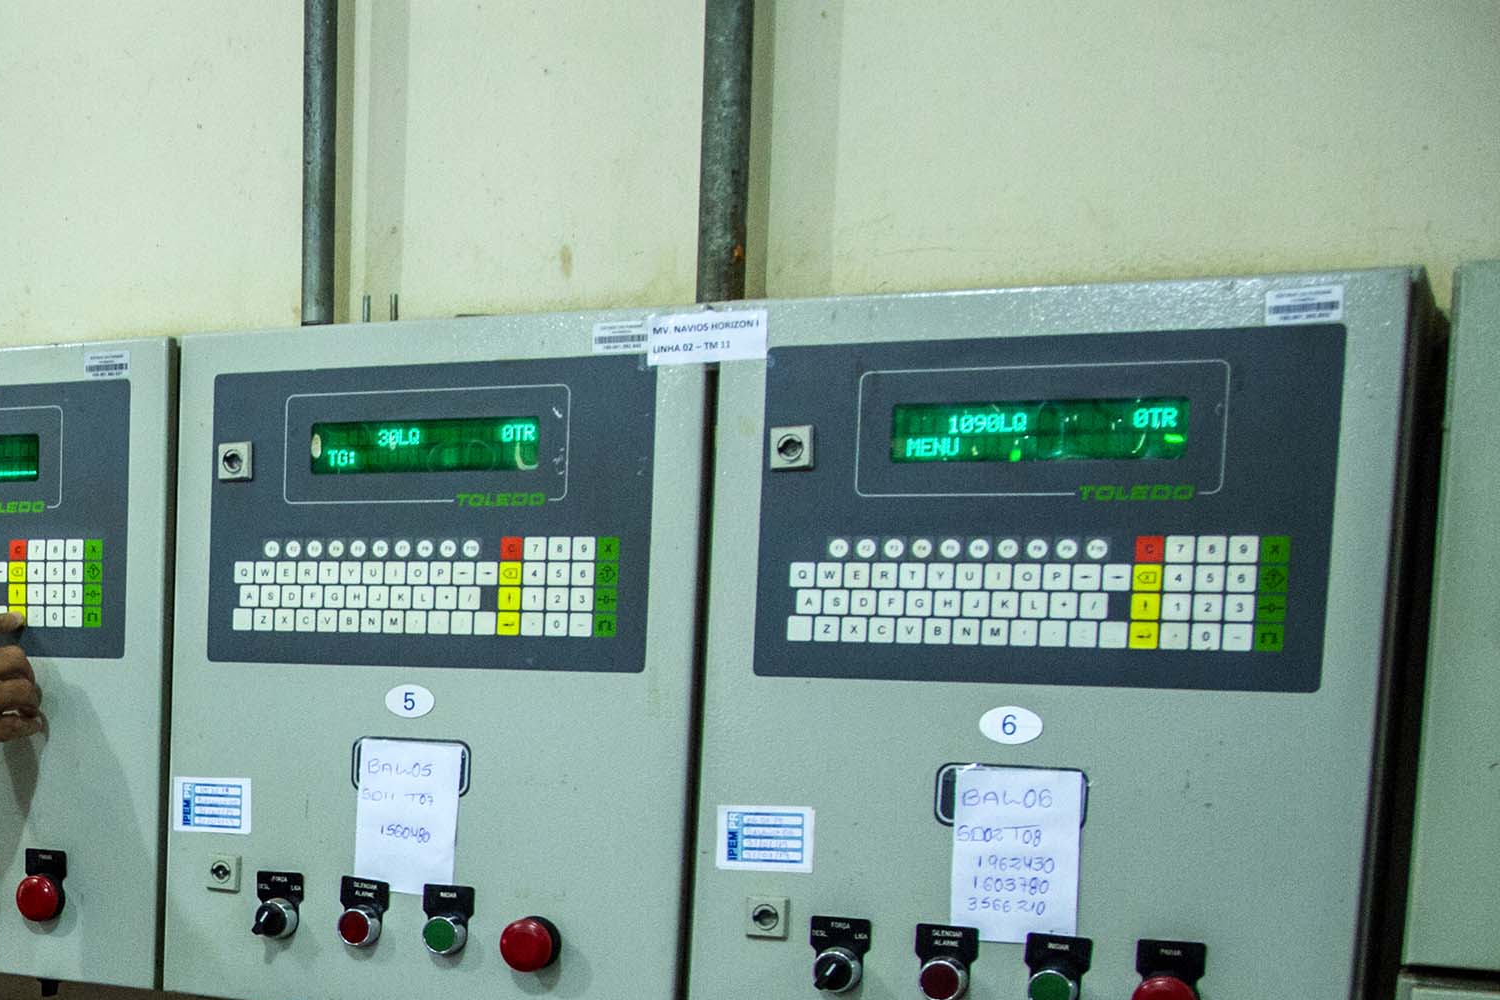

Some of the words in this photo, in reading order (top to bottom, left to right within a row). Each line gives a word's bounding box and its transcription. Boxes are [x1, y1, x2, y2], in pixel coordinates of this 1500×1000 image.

[653, 327, 672, 335] MV.
[674, 322, 709, 333] NAVIOS
[711, 320, 754, 331] HORIZON
[653, 344, 680, 354] LINHA
[682, 343, 694, 352] 02
[704, 341, 718, 350] TM
[948, 413, 1027, 434] 1090LQ
[1132, 407, 1178, 429] 0TR
[378, 427, 421, 447] 30LQ
[501, 423, 536, 443] 0TR
[906, 437, 960, 458] MENU
[456, 492, 547, 507] TOLEDO
[1078, 485, 1196, 501] TOLEDO
[1178, 543, 1185, 553] 7
[1208, 544, 1216, 554] 8
[1239, 544, 1248, 554] 9
[798, 570, 807, 579] Q
[825, 570, 835, 580] W
[853, 570, 860, 580] E
[880, 570, 889, 580] R
[910, 570, 916, 580] T
[937, 571, 945, 580] Y
[965, 572, 974, 581] U
[996, 571, 1001, 581] I
[1022, 571, 1032, 581] O
[1052, 571, 1061, 581] P
[1174, 573, 1182, 583] 4
[1206, 573, 1214, 583] 5
[1237, 574, 1246, 583] 6
[804, 597, 813, 606] A
[832, 597, 841, 607] S
[859, 598, 868, 607] D
[887, 597, 895, 607] F
[915, 599, 924, 608] G
[943, 599, 952, 608] H
[972, 599, 980, 609] J
[1000, 599, 1009, 609] K
[1030, 600, 1037, 610] L
[1175, 602, 1181, 611] 1
[1204, 603, 1212, 612] 2
[1236, 603, 1244, 612] 3
[823, 624, 831, 633] Z
[850, 625, 858, 634] X
[876, 625, 885, 635] C
[905, 625, 914, 635] V
[933, 626, 942, 635] B
[962, 627, 971, 637] N
[991, 627, 1000, 637] M
[1201, 632, 1210, 641] 0
[404, 692, 415, 710] 5
[1003, 715, 1016, 735] 6
[182, 799, 191, 826] IPEM
[727, 831, 738, 861] IPEM
